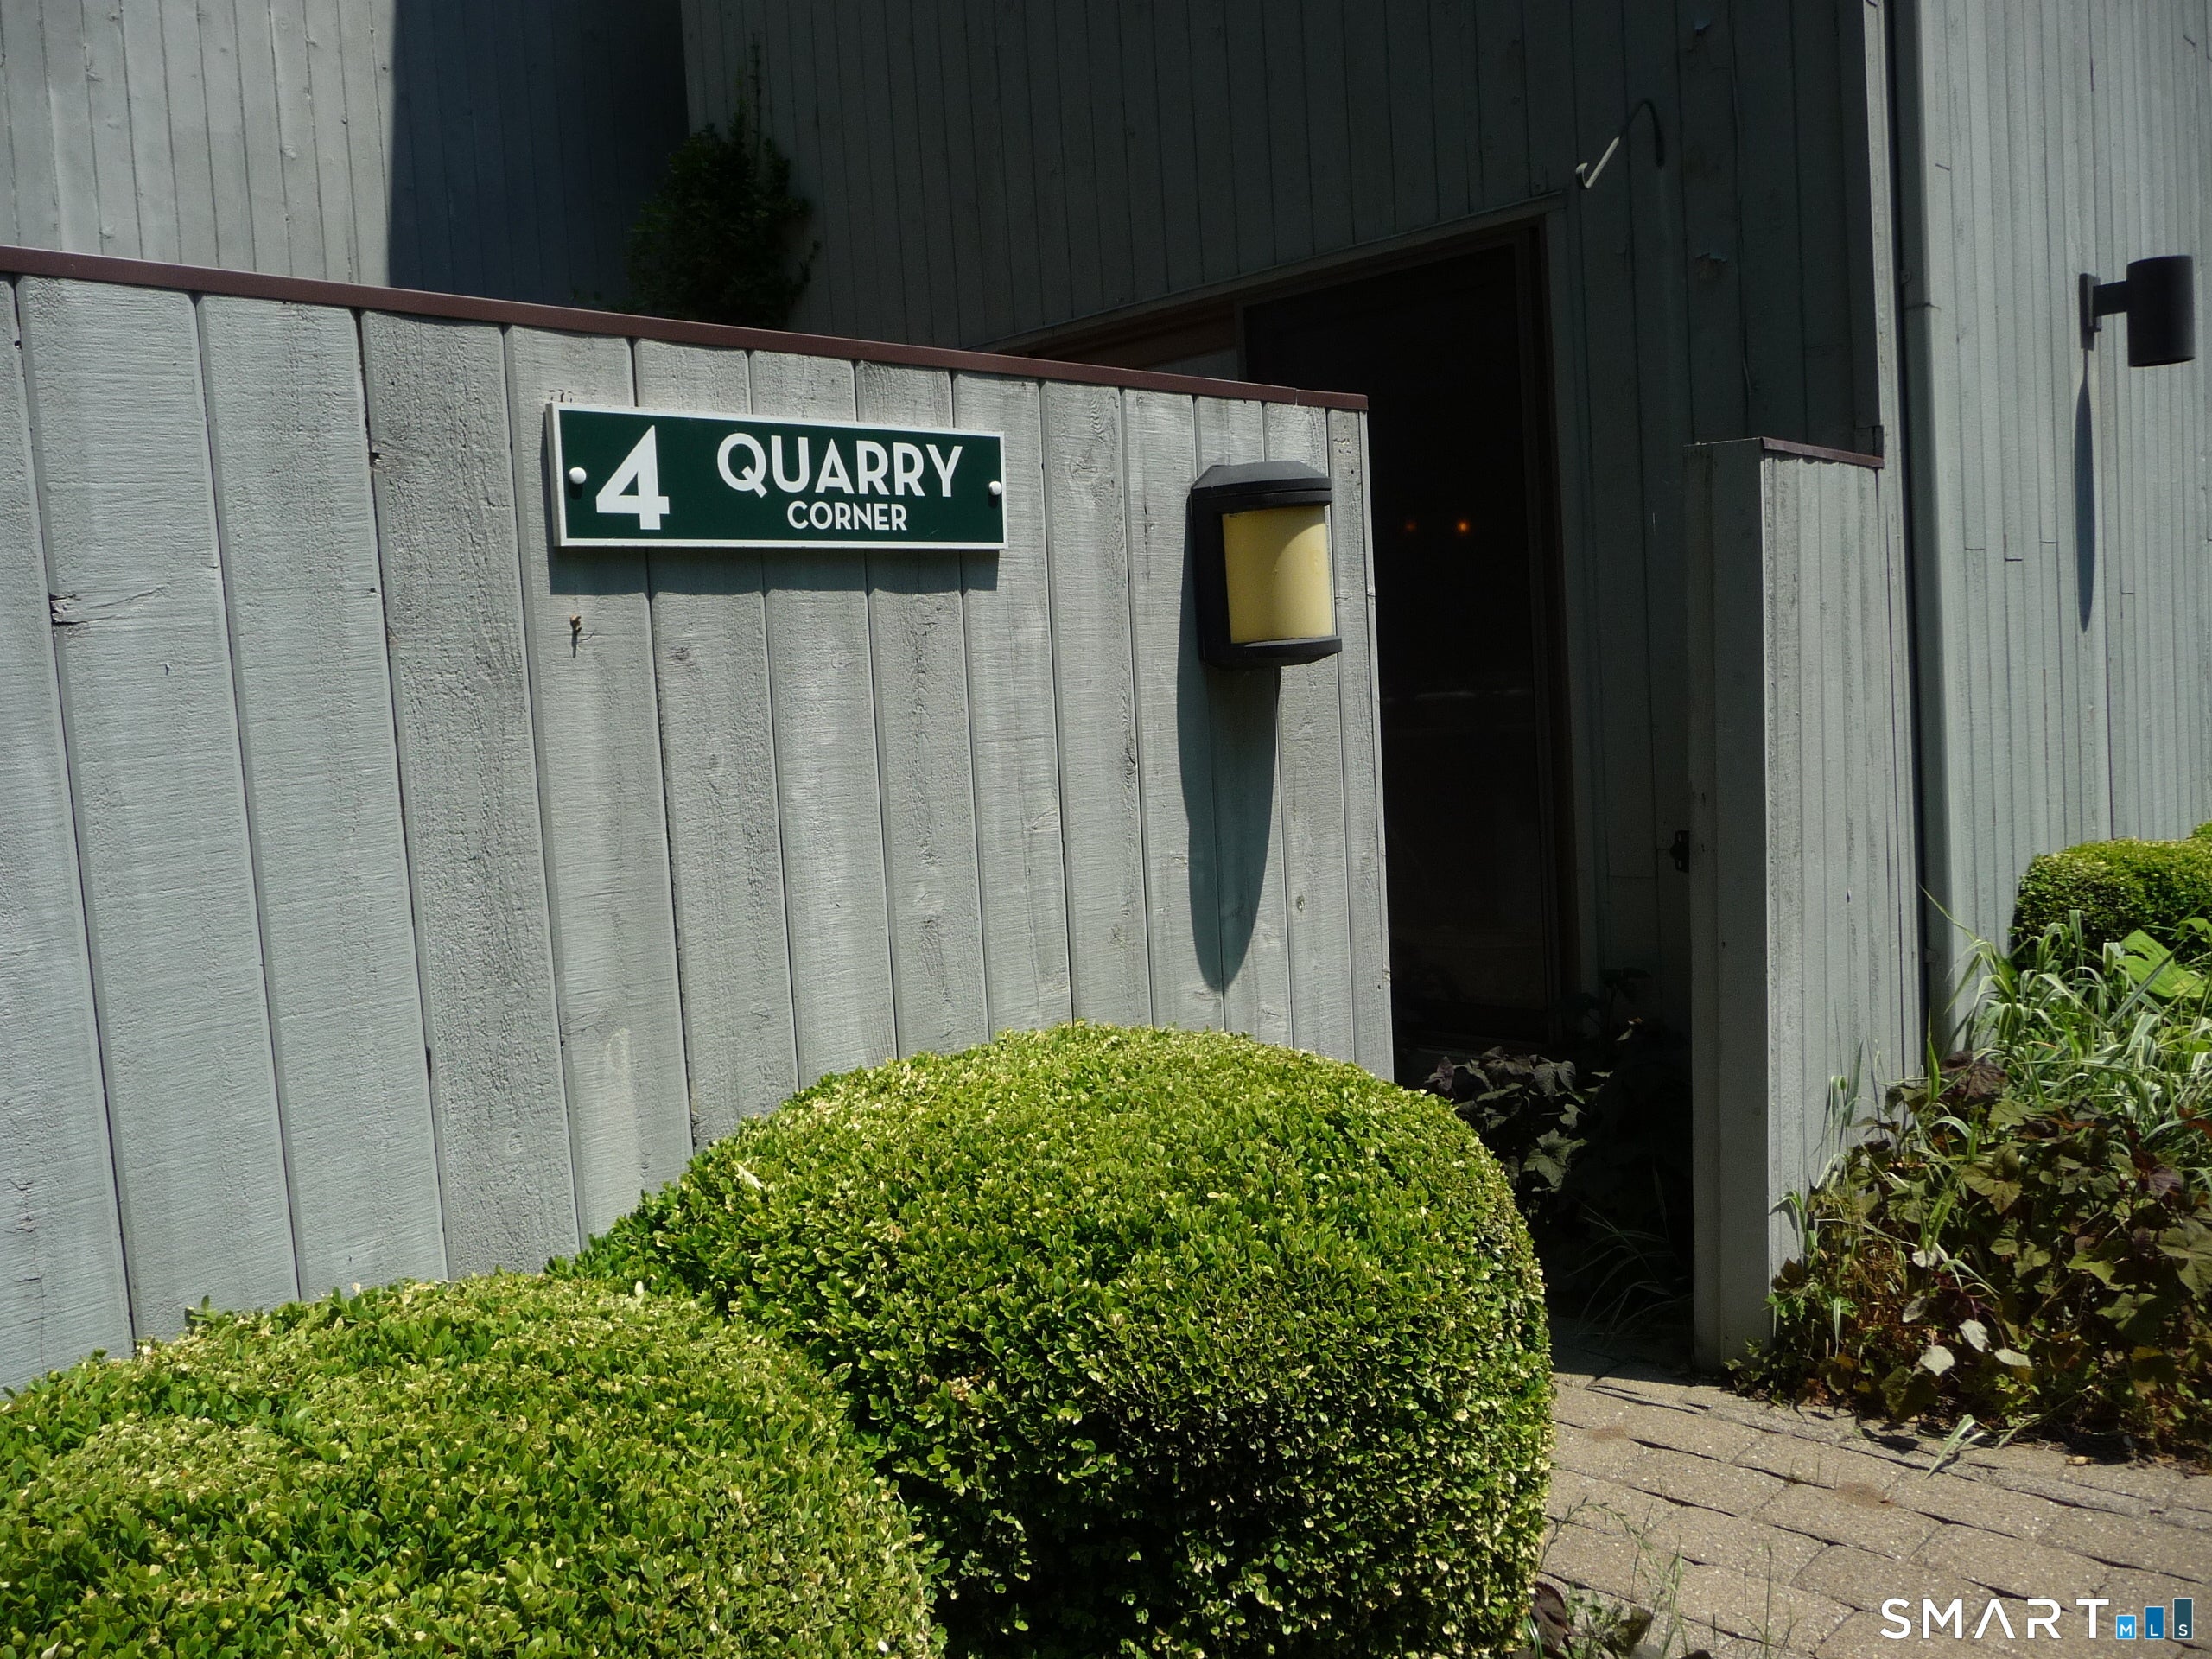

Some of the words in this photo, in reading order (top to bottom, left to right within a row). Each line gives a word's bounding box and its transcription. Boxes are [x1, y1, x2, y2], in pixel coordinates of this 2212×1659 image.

[595, 424, 670, 531] 4
[716, 432, 963, 498] QUARRY
[787, 500, 907, 531] CORNER
